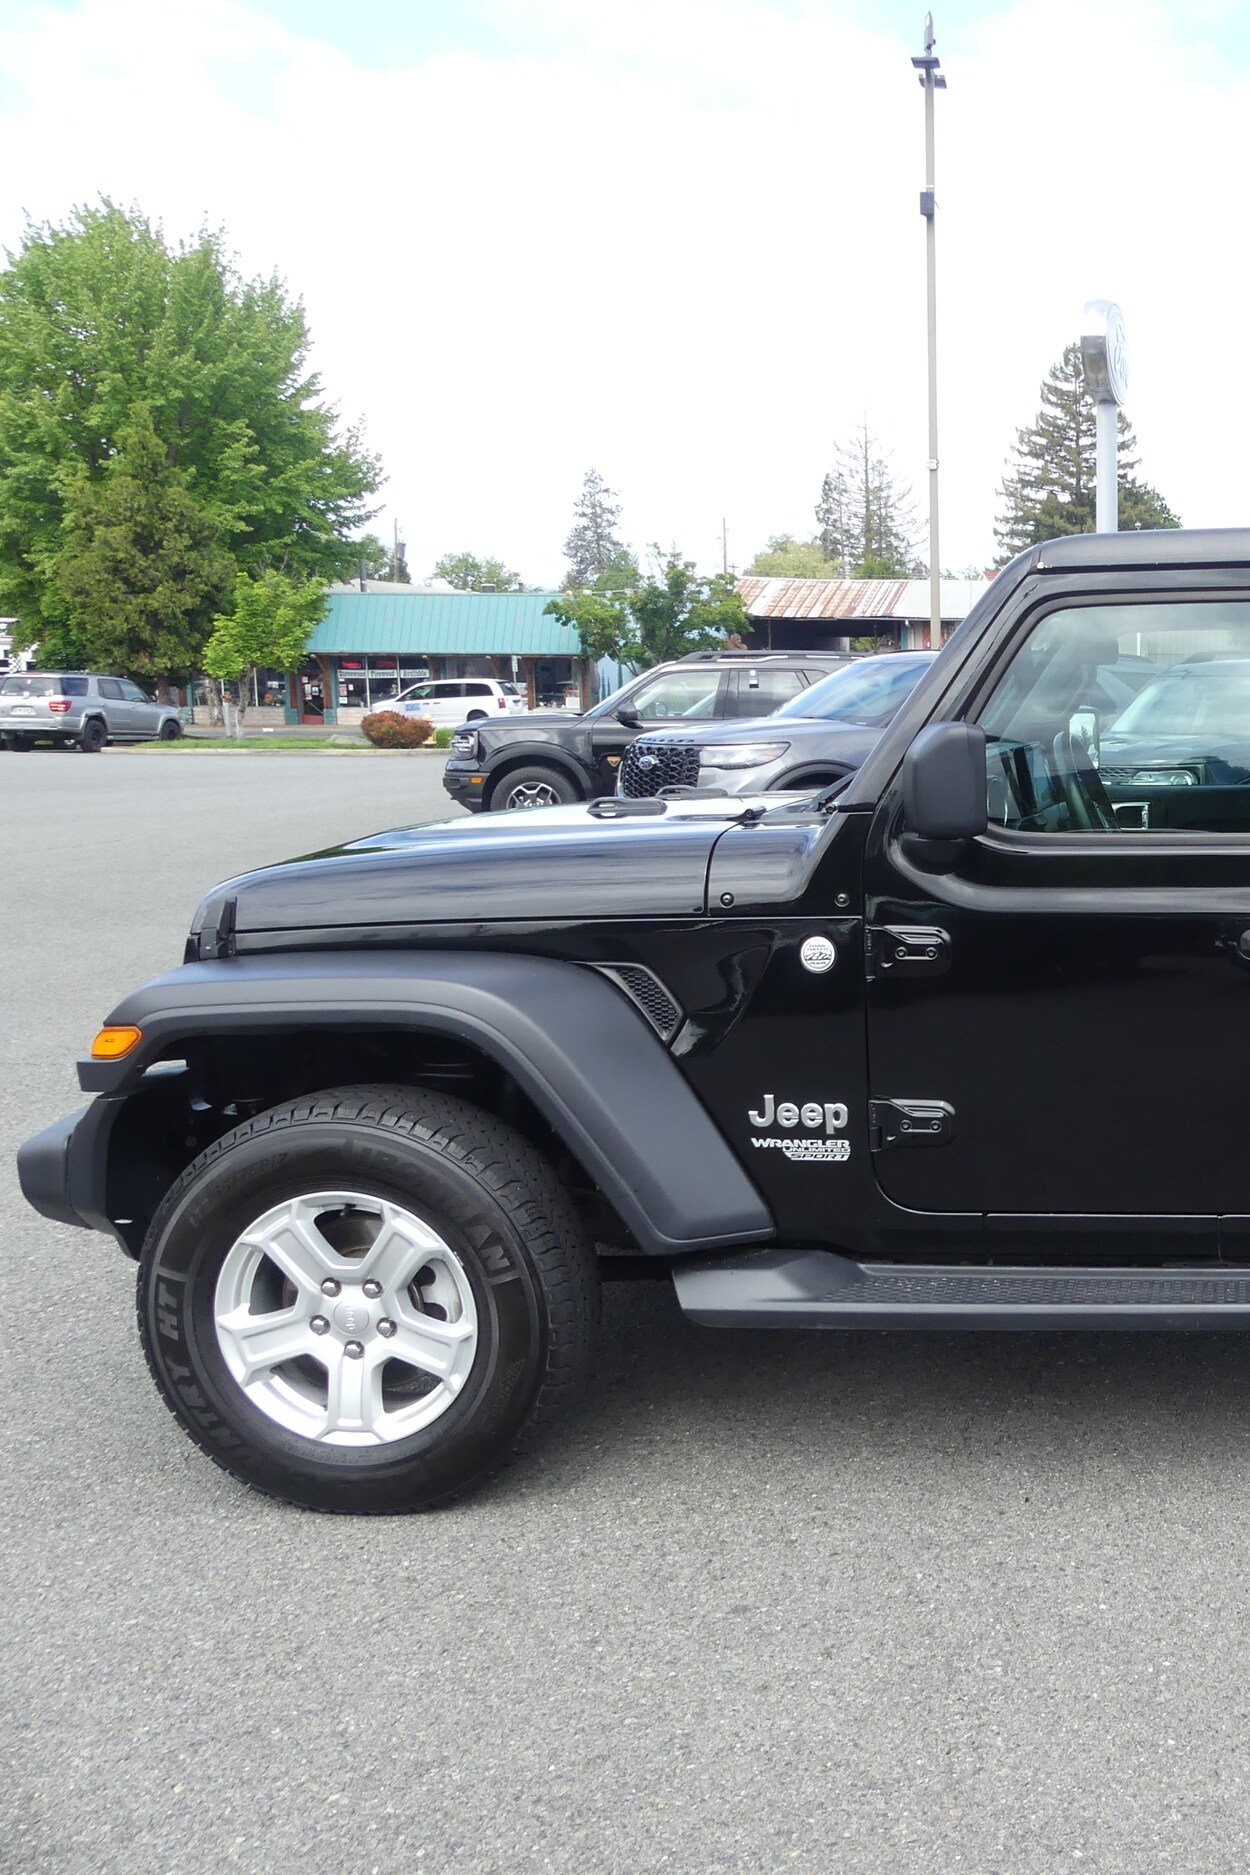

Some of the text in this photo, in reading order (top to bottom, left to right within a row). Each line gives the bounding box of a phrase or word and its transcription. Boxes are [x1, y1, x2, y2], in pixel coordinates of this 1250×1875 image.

[748, 1094, 848, 1134] Jeep
[750, 1137, 850, 1148] WRANGLER
[157, 1281, 180, 1341] HT
